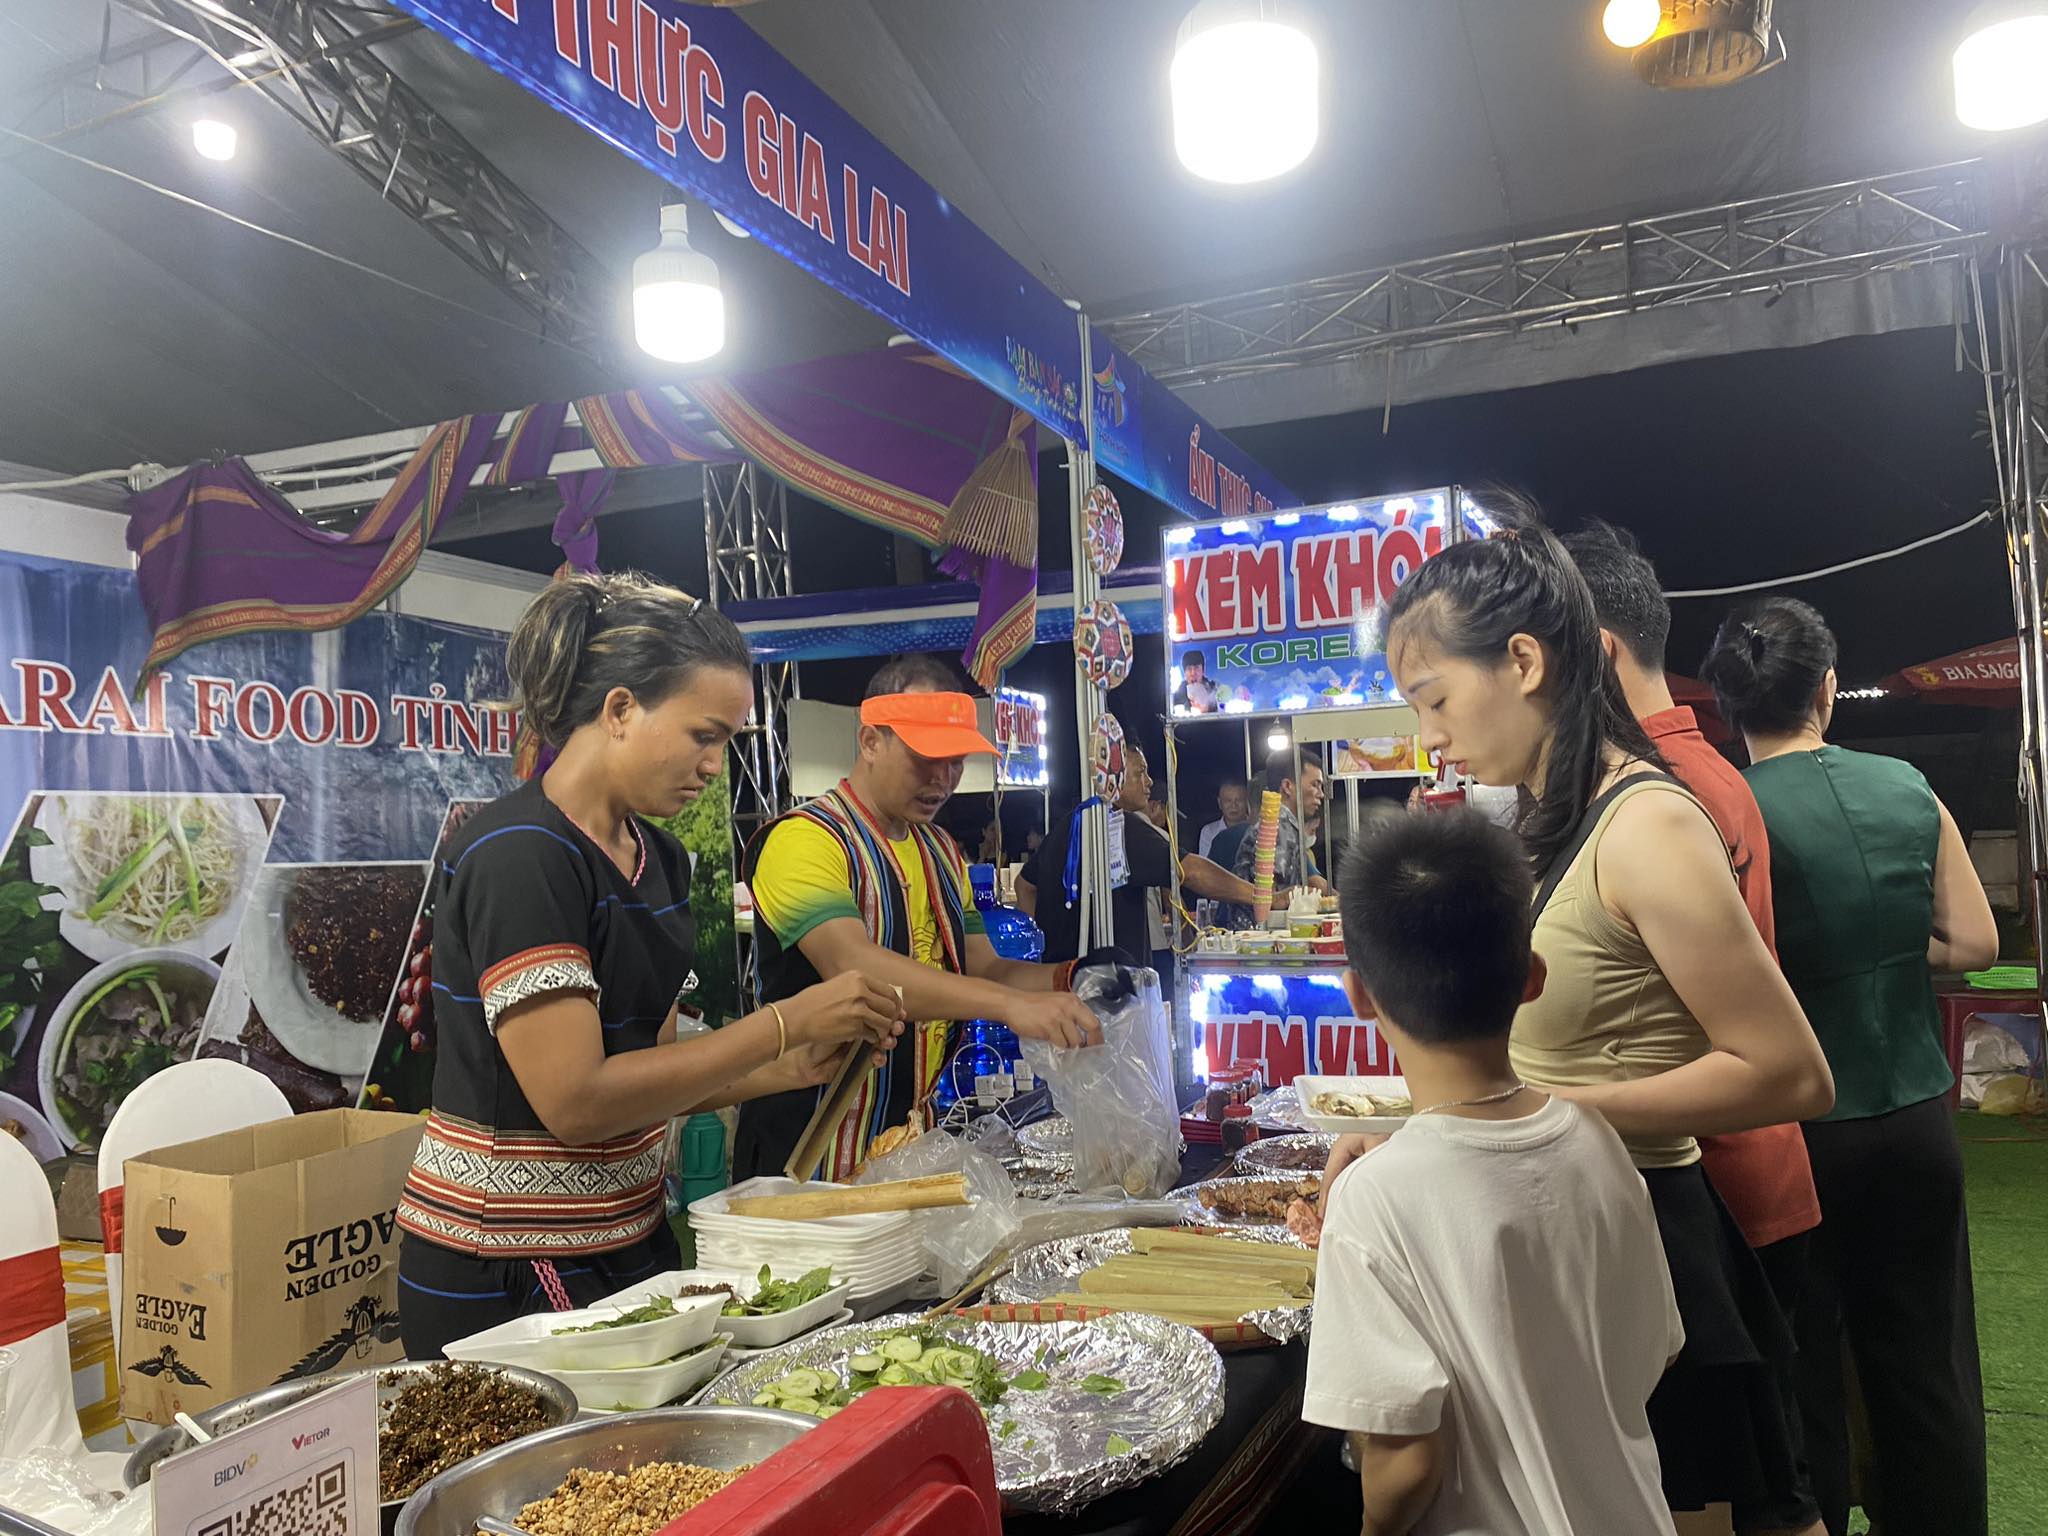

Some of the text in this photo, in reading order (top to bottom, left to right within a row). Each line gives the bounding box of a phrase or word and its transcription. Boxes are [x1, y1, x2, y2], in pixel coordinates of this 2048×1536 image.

[742, 90, 835, 244] GIA
[843, 163, 911, 297] LAI
[1188, 423, 1217, 510] ẨM
[1171, 545, 1284, 635] KEM
[1941, 664, 1978, 681] BIA
[189, 674, 380, 748] FOOD
[391, 682, 521, 757] TỈNH
[285, 1254, 381, 1301] GOLDEN
[136, 1294, 207, 1341] EAGLE
[136, 1313, 179, 1336] GOLDEN
[214, 1461, 247, 1487] BIDV
